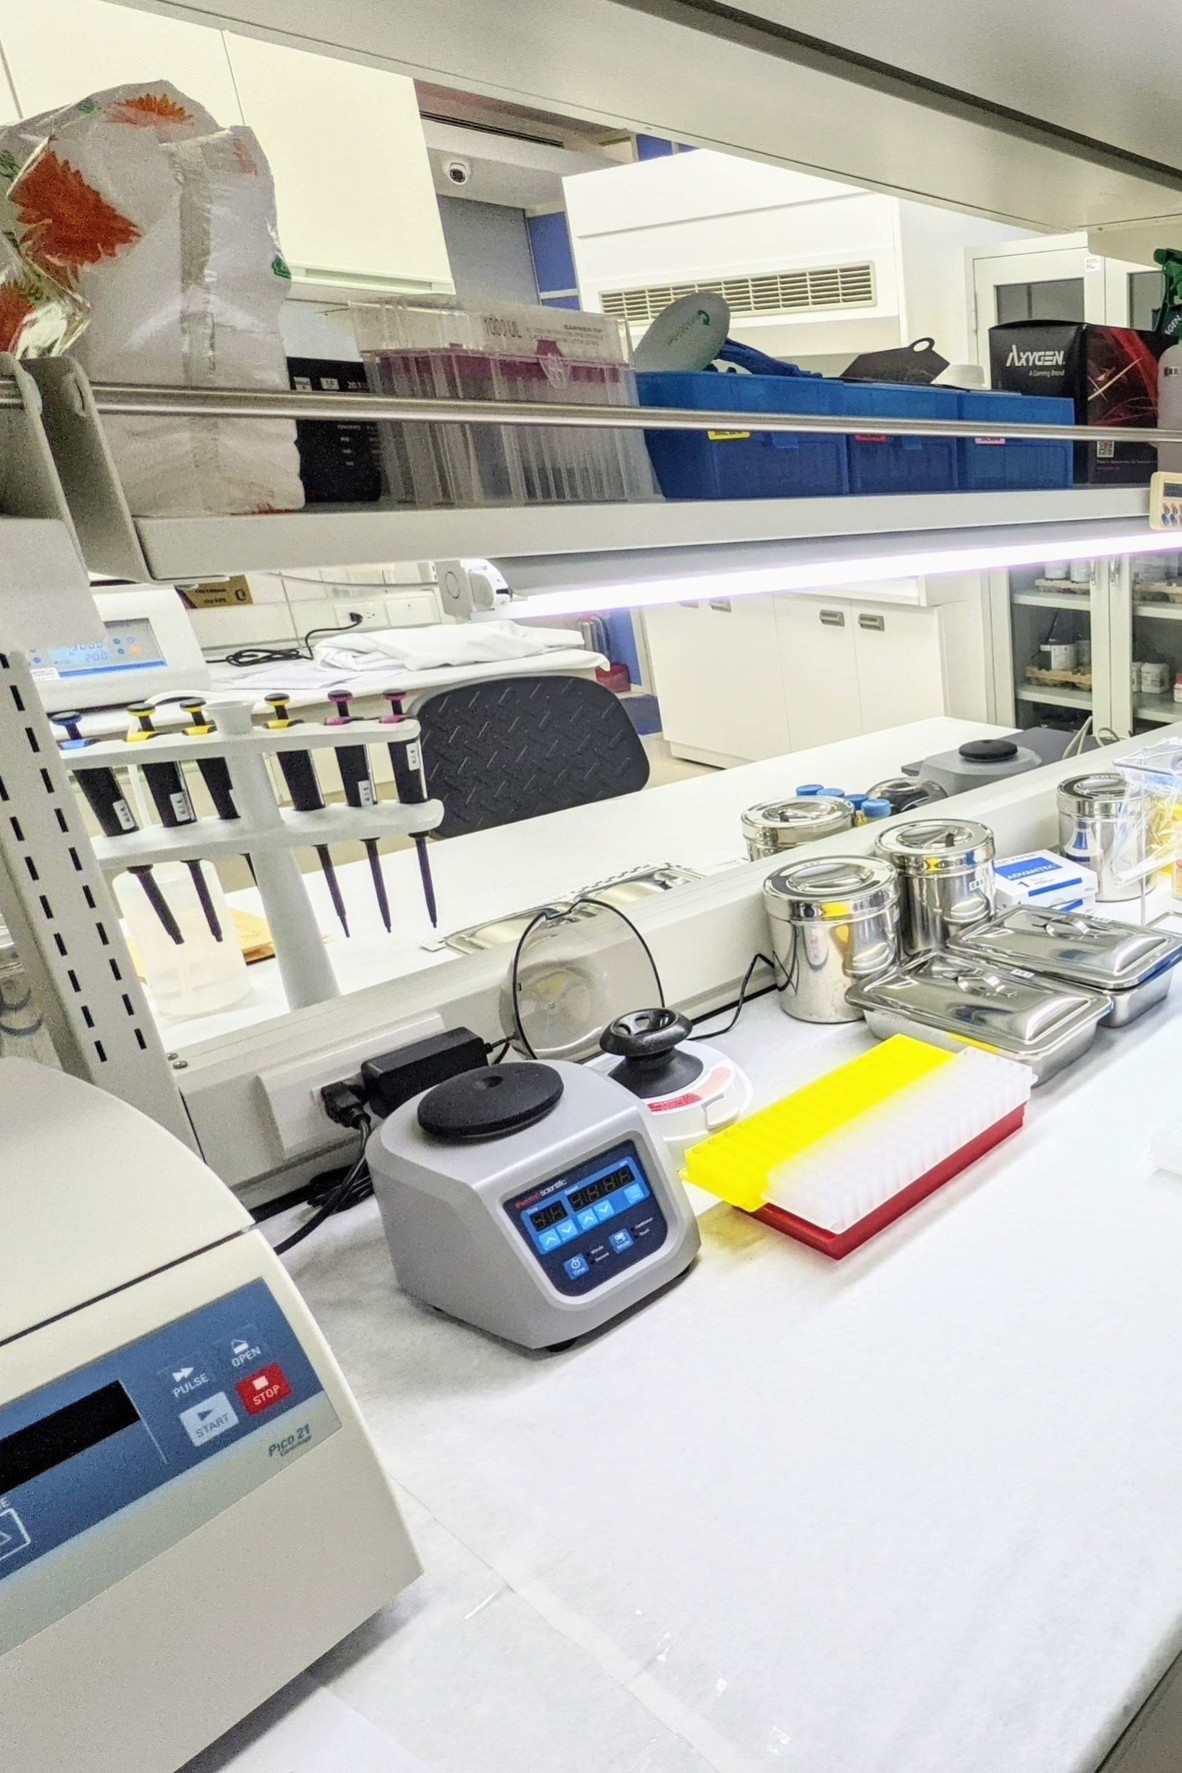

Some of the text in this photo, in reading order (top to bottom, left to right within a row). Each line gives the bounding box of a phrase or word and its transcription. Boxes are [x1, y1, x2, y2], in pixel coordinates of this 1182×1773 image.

[1006, 344, 1065, 367] AXYGEN
[231, 1346, 262, 1368] OPEN
[172, 1372, 210, 1398] PULSE
[253, 1384, 281, 1406] STOP
[195, 1412, 230, 1439] START
[295, 1424, 312, 1439] 21
